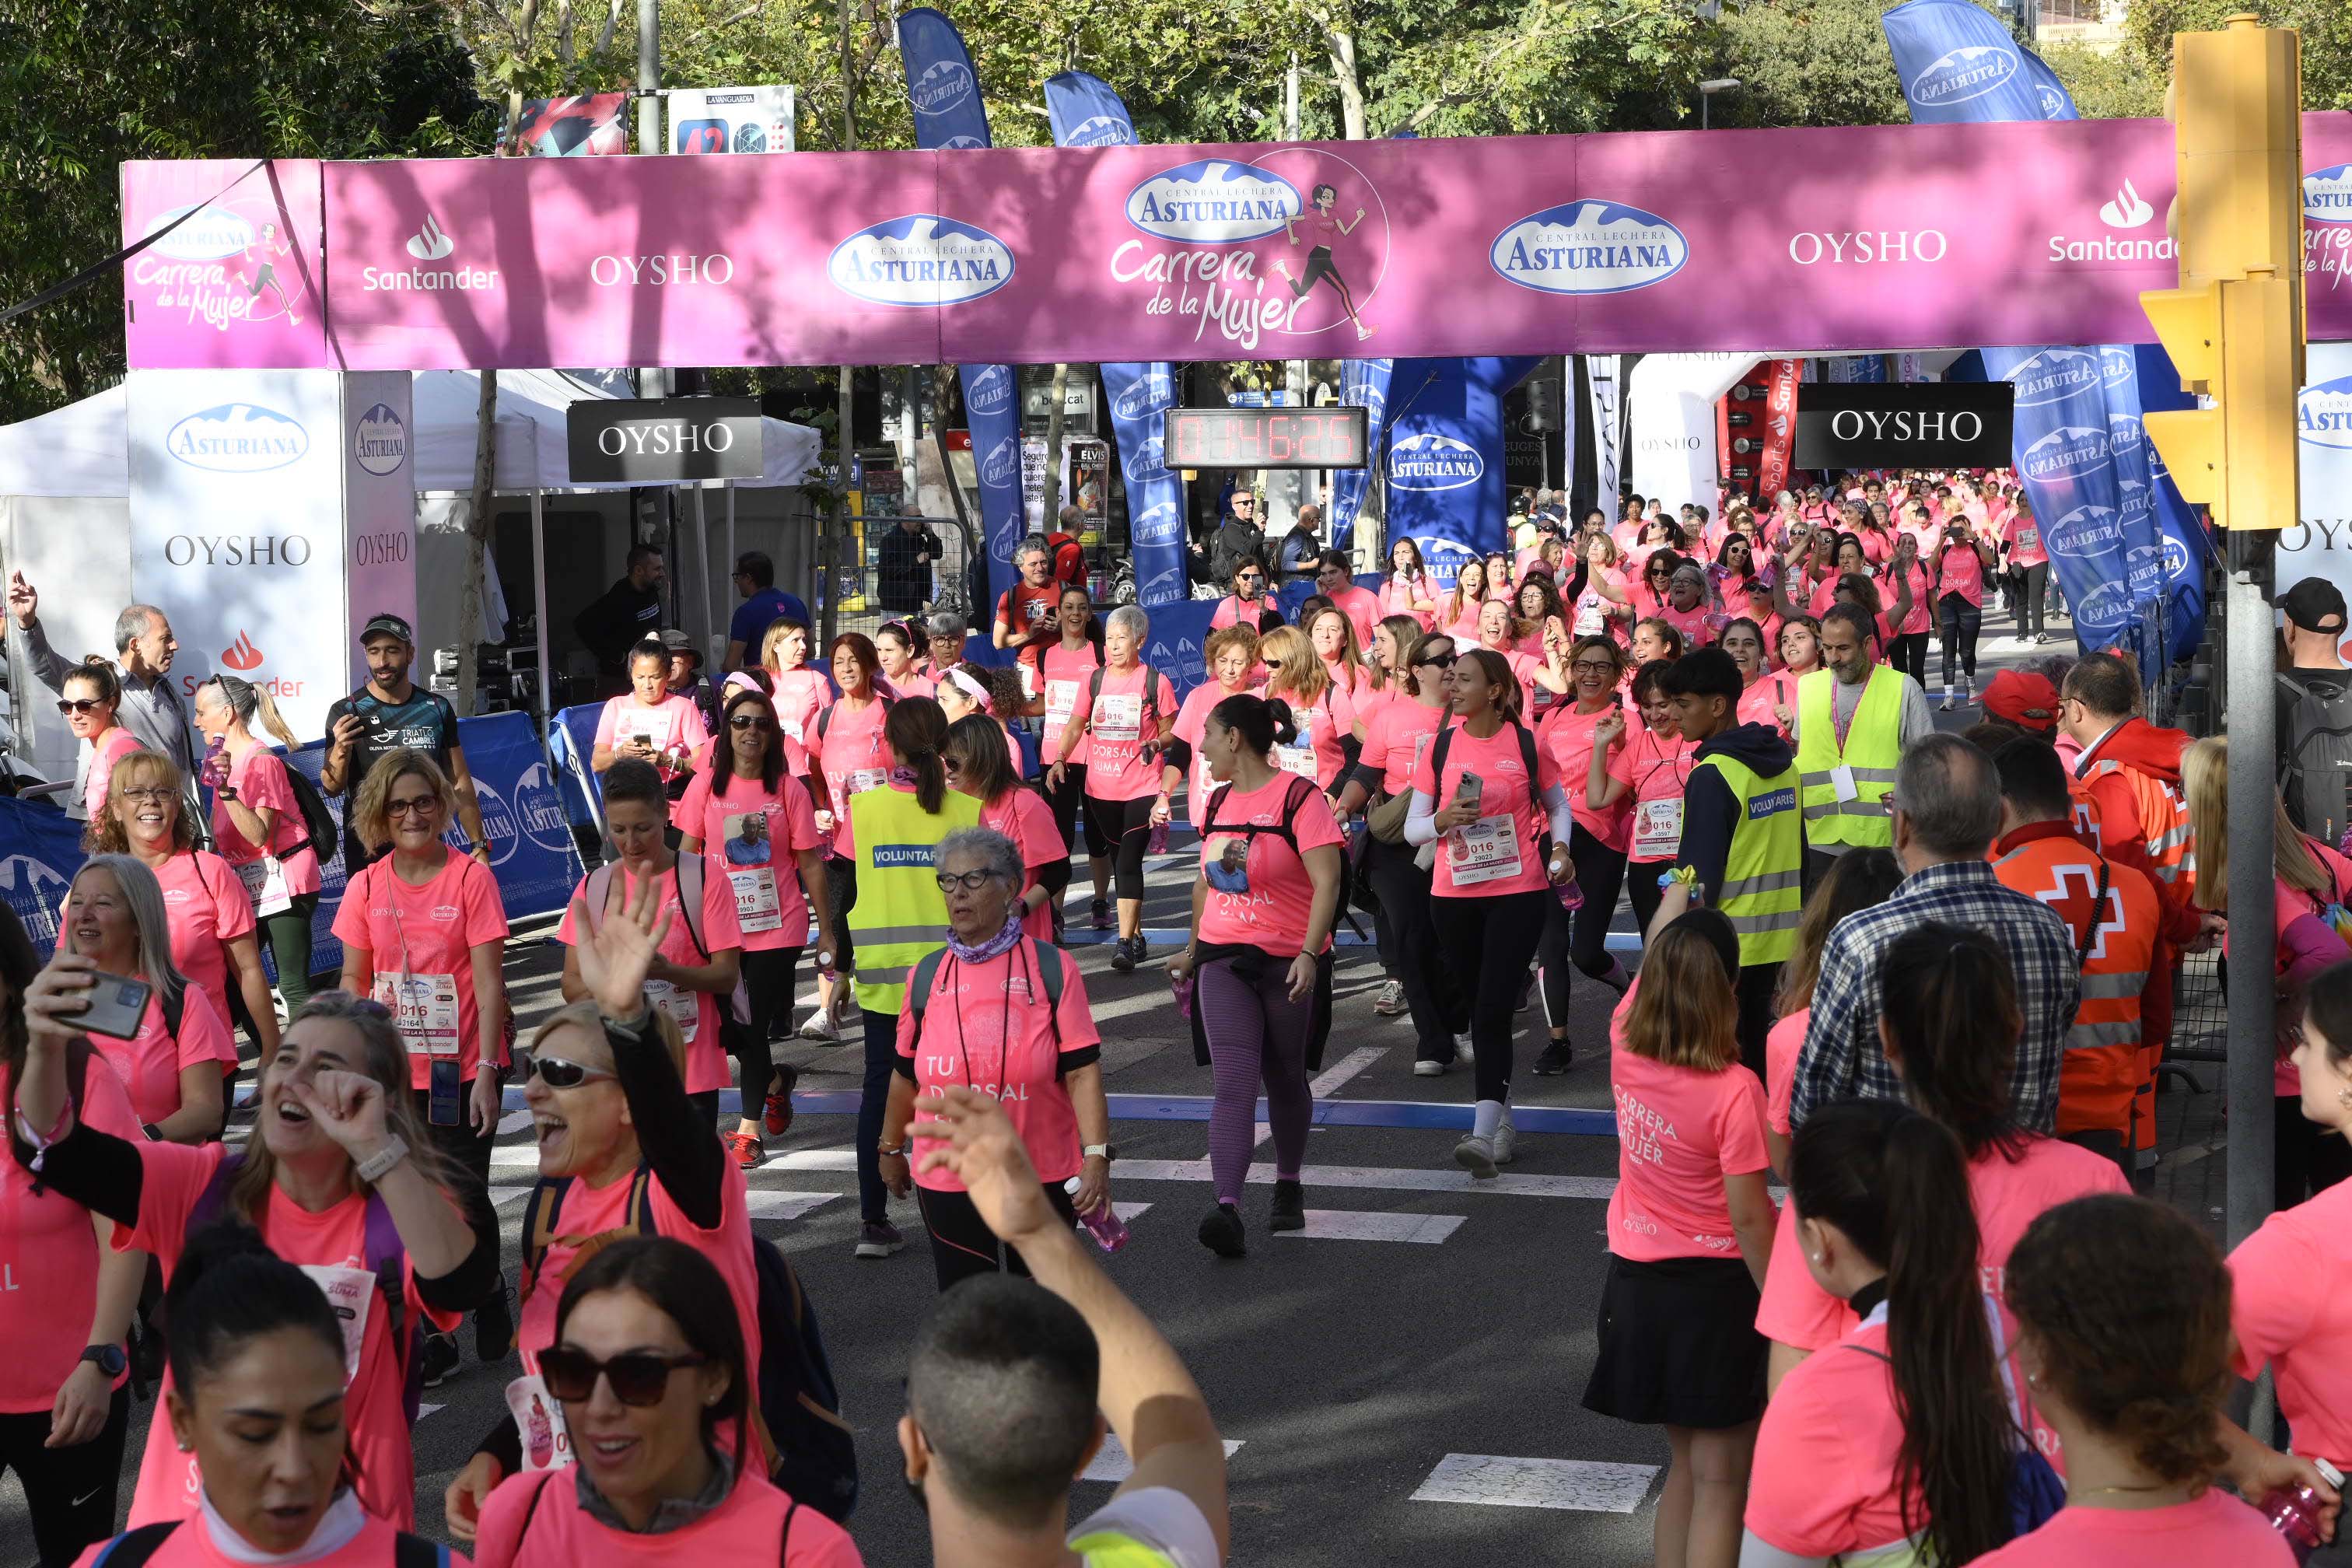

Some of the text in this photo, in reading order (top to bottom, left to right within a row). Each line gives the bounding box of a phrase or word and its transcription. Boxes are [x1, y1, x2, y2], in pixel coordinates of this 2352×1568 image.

[1166, 188, 1220, 198] CENTRAL
[1139, 191, 1289, 223] ASTURIANA
[1535, 231, 1667, 243] CENTRAL LECHERA
[1789, 229, 1947, 264] OYSHO
[2048, 236, 2178, 262] Santand
[870, 247, 930, 257] CENTRAL
[1110, 239, 1256, 283] Carrera
[1505, 236, 1673, 272] ASTURIANA
[133, 256, 226, 285] Carrera
[590, 254, 733, 286] OYSHO
[844, 250, 1001, 282] ASTURIANA
[363, 265, 499, 292] Santander
[156, 285, 261, 331] de la Mujer
[1146, 278, 1311, 350] de la Mujer
[1178, 416, 1354, 460] 01:46:25
[1832, 410, 1983, 442] OYSHO
[178, 429, 299, 456] ASTURIANA
[358, 431, 404, 458] ASTURIANA
[597, 422, 733, 456] OYSHO
[1081, 450, 1104, 460] ELVIS
[1764, 440, 1785, 492] Sports
[1388, 460, 1477, 479] ASTURIANA
[164, 535, 311, 566] OYSHO
[356, 531, 408, 566] OYSHO
[184, 675, 305, 698] Sader
[1107, 712, 1123, 721] 016
[402, 737, 436, 746] CAMBRILS
[1093, 744, 1136, 759] DORSAL
[1094, 760, 1122, 773] SUMA
[712, 801, 739, 810] OYSHO
[453, 814, 516, 847] ASRIANA
[1465, 828, 1495, 838] ASTURIANA
[1653, 821, 1672, 830] 016
[1471, 842, 1494, 854] 016
[1474, 852, 1493, 862] 29023
[712, 854, 728, 870] TU
[1458, 863, 1478, 872] CARRERA
[1458, 866, 1516, 880] OYSHO Santander
[401, 1004, 428, 1017] 016
[926, 1055, 954, 1076] TU
[930, 1082, 1029, 1103] DRSAL
[1614, 1083, 1678, 1140] CARRERA
[1618, 1128, 1664, 1165] MUJER
[1640, 1123, 1661, 1147] LA
[1622, 1218, 1657, 1236] OYSHO
